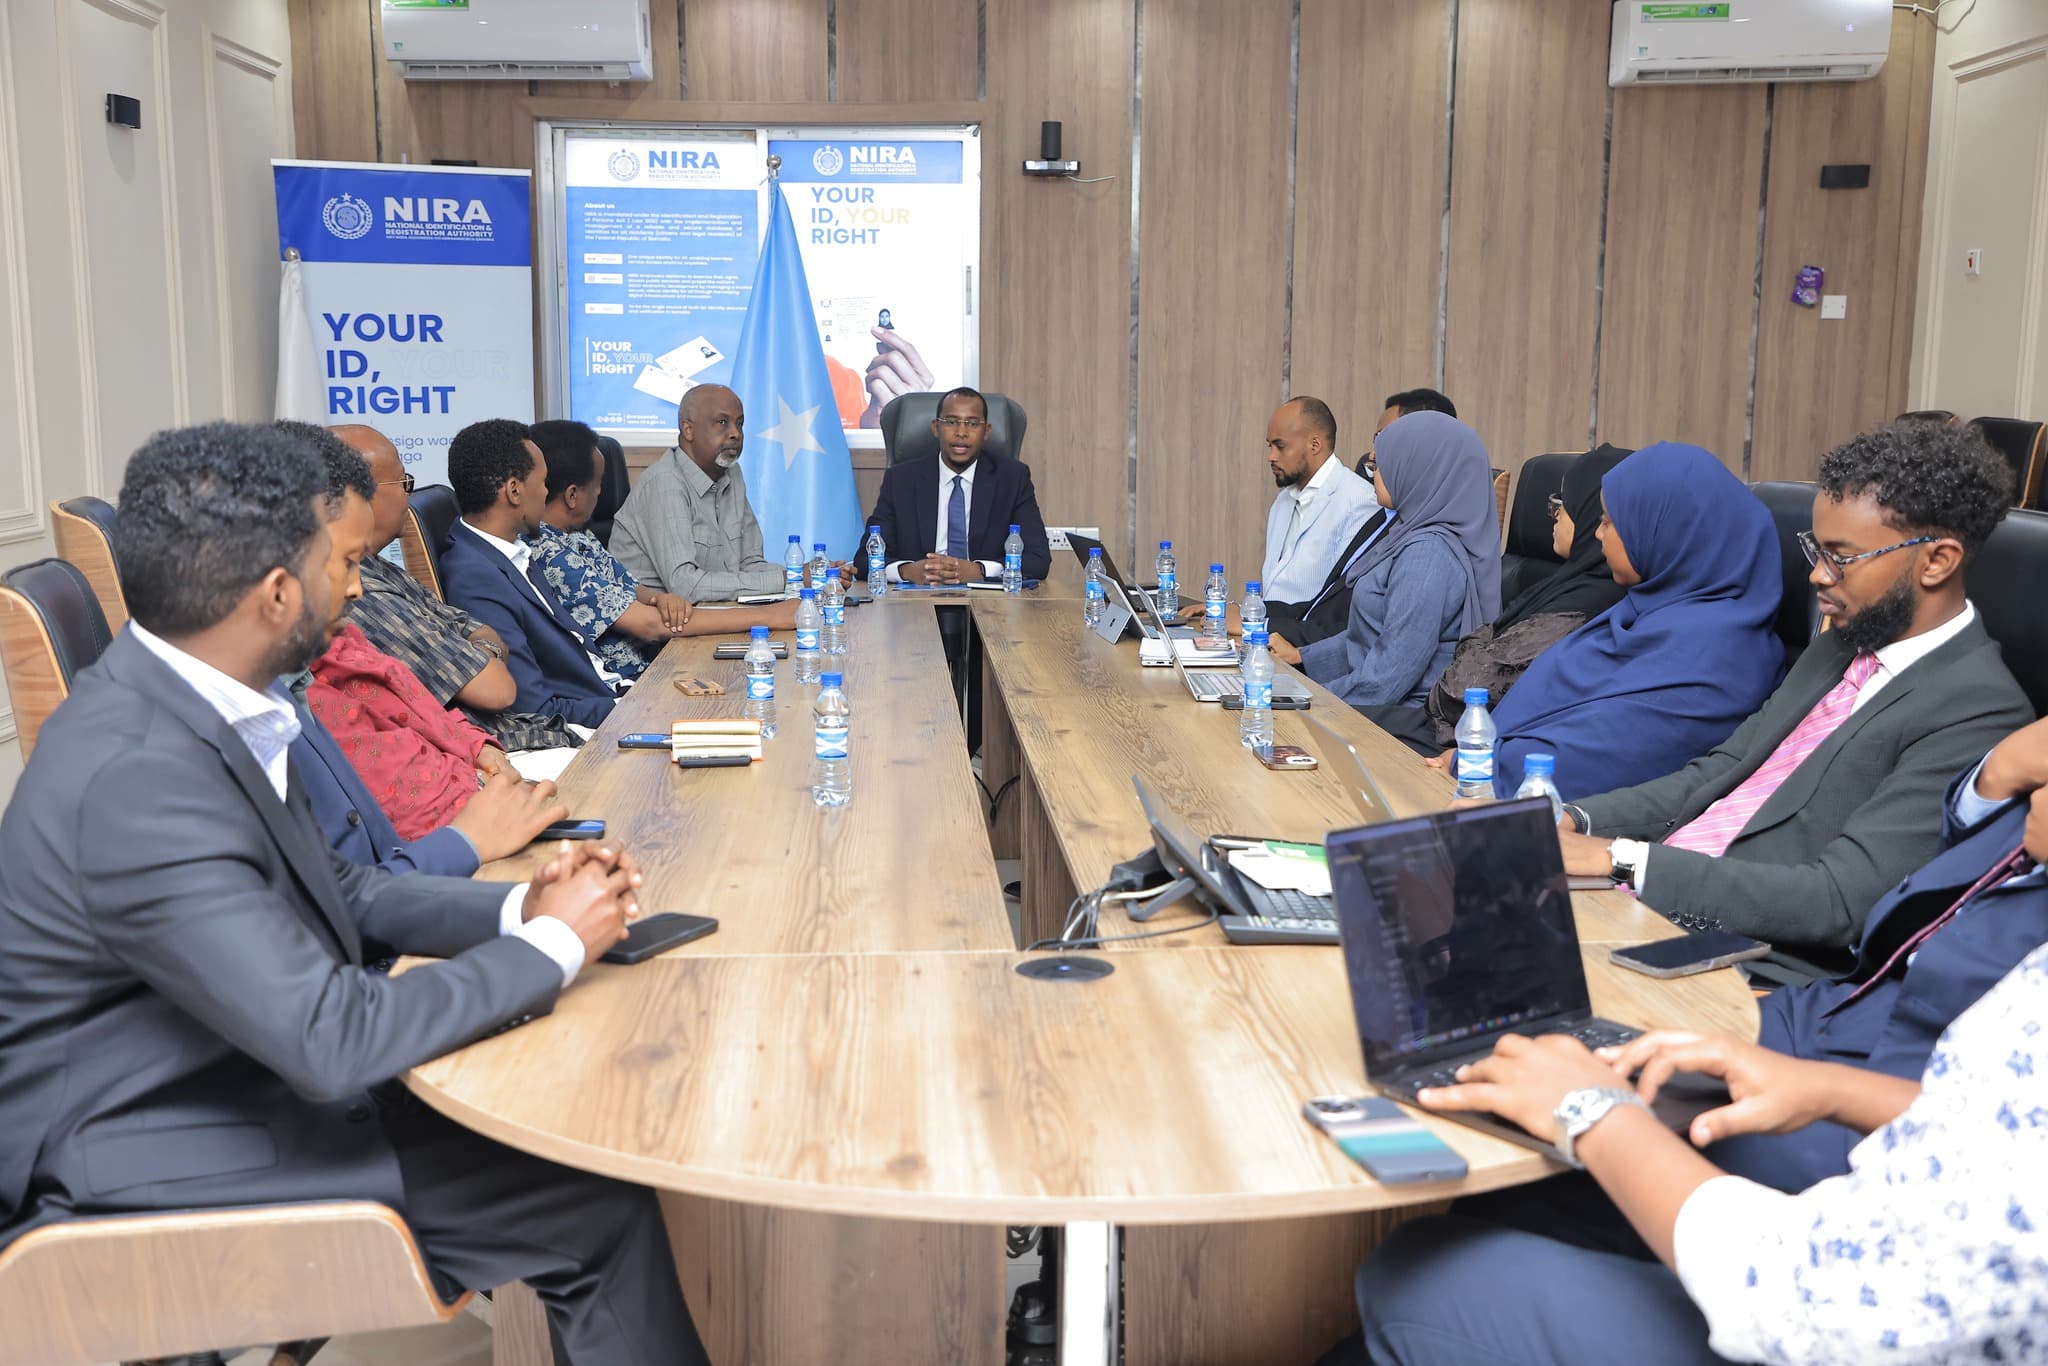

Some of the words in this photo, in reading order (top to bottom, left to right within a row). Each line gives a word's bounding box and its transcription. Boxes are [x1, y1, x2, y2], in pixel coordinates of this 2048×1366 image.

[649, 150, 720, 169] NIRA
[849, 145, 917, 163] NIRA
[811, 186, 875, 204] YOUR
[384, 197, 492, 224] NIRA
[811, 207, 839, 226] ID,
[846, 207, 910, 225] YOUR
[385, 222, 424, 230] NATIONAL
[425, 223, 484, 231] IDENTIFICATION
[386, 229, 445, 237] REGISTRATION
[447, 230, 493, 238] AUTHORITY
[812, 228, 880, 245] RIGHT
[323, 313, 443, 342] YOUR
[592, 340, 632, 352] YOUR
[326, 350, 380, 383] ID,
[592, 352, 611, 364] ID,
[612, 352, 654, 364] YOUR
[592, 363, 636, 375] RIGHT
[328, 385, 456, 414] RIGHT
